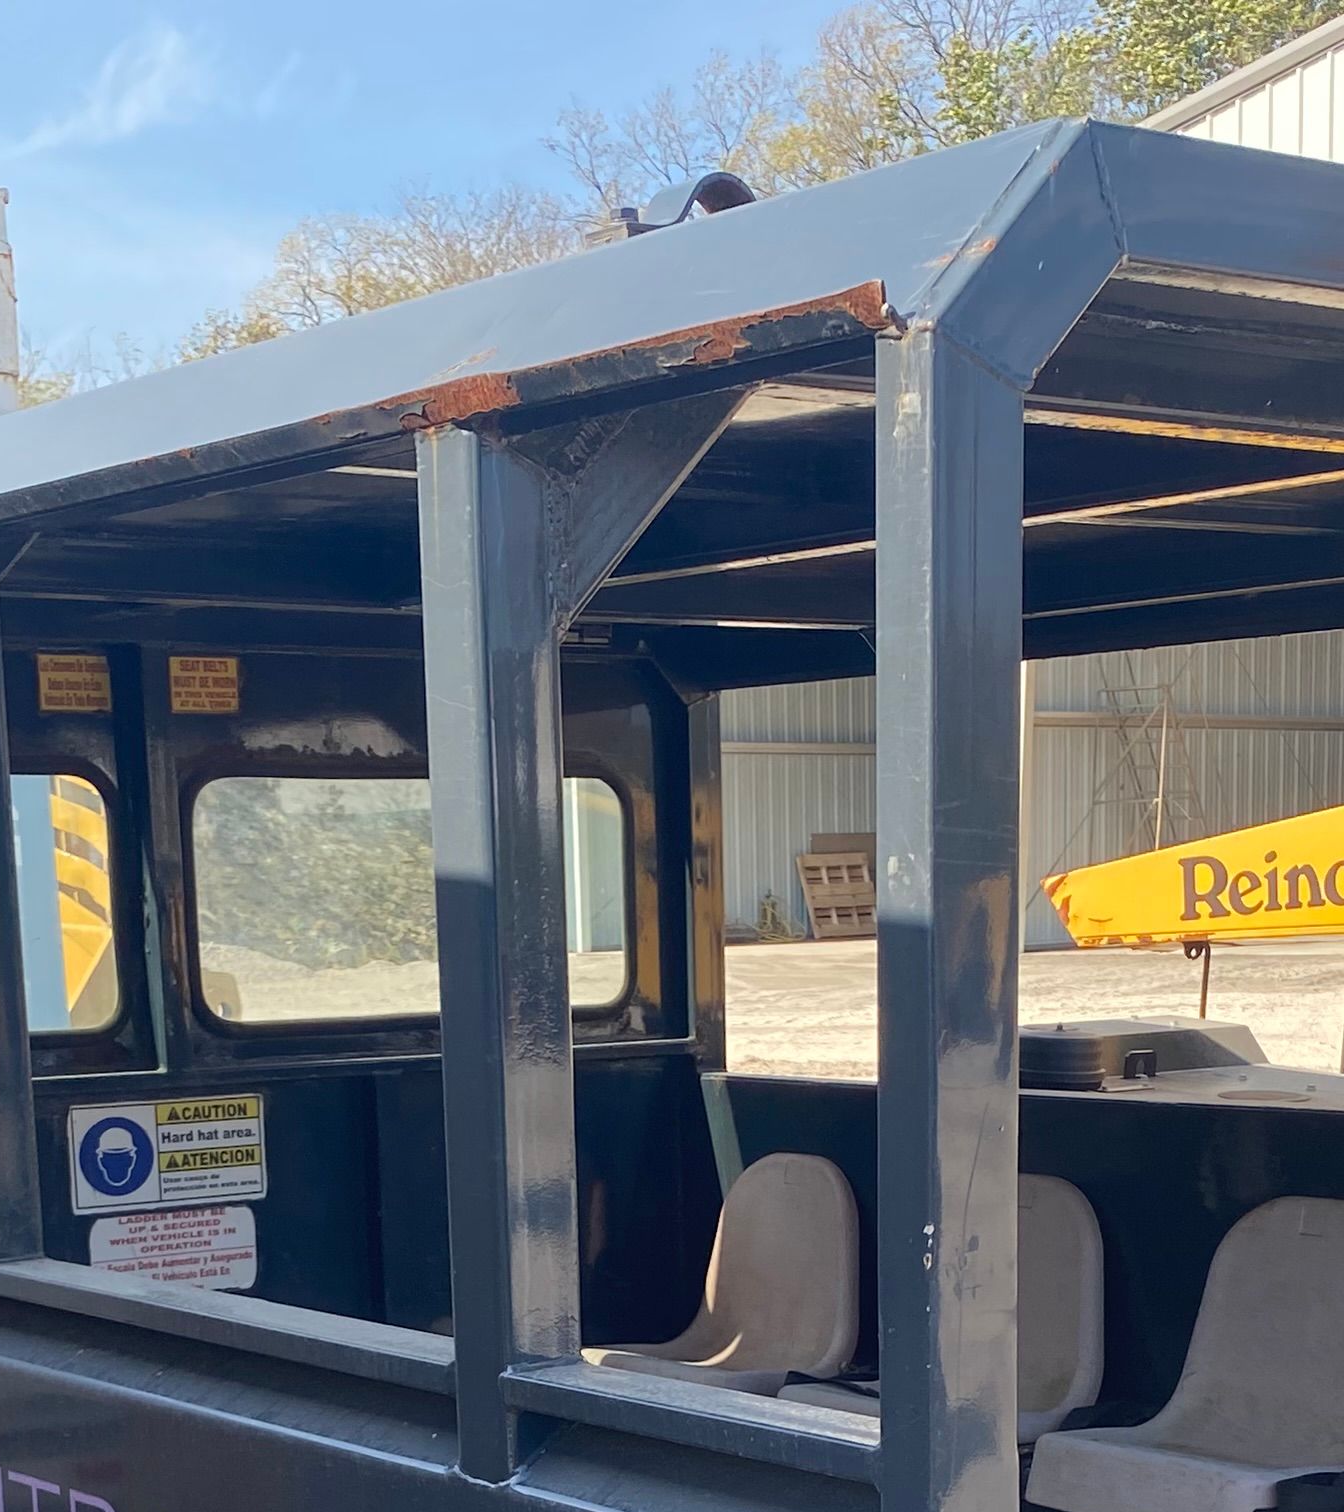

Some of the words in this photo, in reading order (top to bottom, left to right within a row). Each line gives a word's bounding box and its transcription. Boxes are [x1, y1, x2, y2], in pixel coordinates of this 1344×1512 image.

[179, 660, 200, 672] SEAT
[203, 660, 228, 673] BELTS
[173, 676, 196, 688] MUST
[182, 1102, 248, 1121] CAUTION
[161, 1130, 194, 1144] Hard
[197, 1127, 219, 1141] hat
[222, 1127, 257, 1139] area.
[181, 1148, 256, 1168] ATENCION
[118, 1211, 168, 1225] LADDER
[172, 1208, 206, 1220] MUST
[128, 1226, 146, 1235] UP
[163, 1219, 222, 1231] SECURED
[109, 1236, 148, 1246] WHEN
[151, 1230, 204, 1241] VEHICLE
[207, 1228, 220, 1237] IS
[223, 1227, 237, 1235] IN
[140, 1240, 212, 1254] OPERATION
